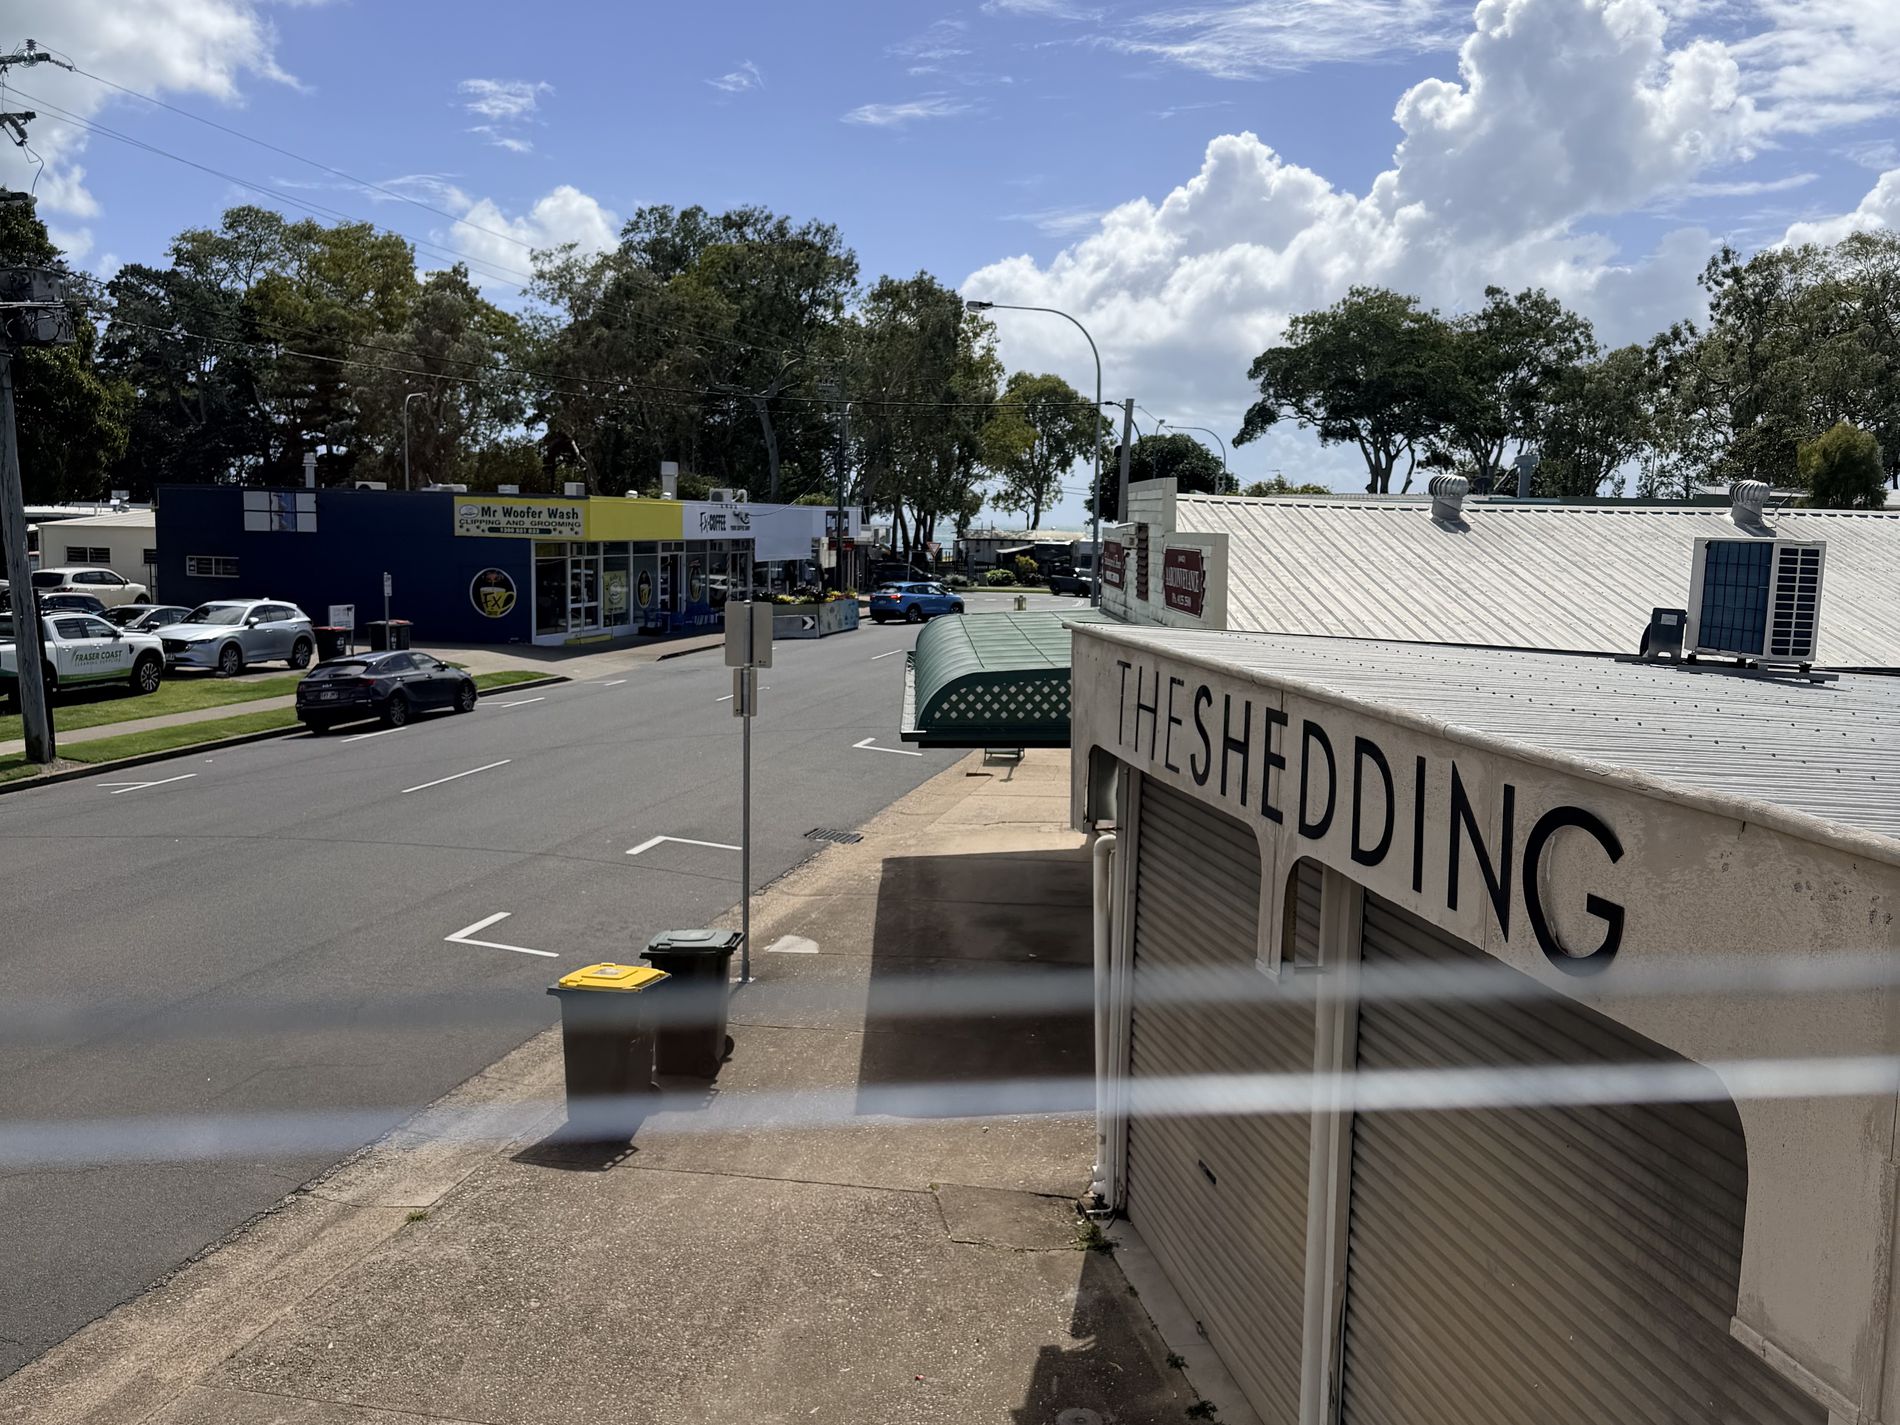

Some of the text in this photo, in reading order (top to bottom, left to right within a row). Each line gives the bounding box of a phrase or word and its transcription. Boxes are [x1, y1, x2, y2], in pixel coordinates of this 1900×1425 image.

[481, 506, 579, 520] Mr Woofer Wash
[530, 520, 581, 528] GROOMING
[75, 650, 122, 661] FRASER COAST
